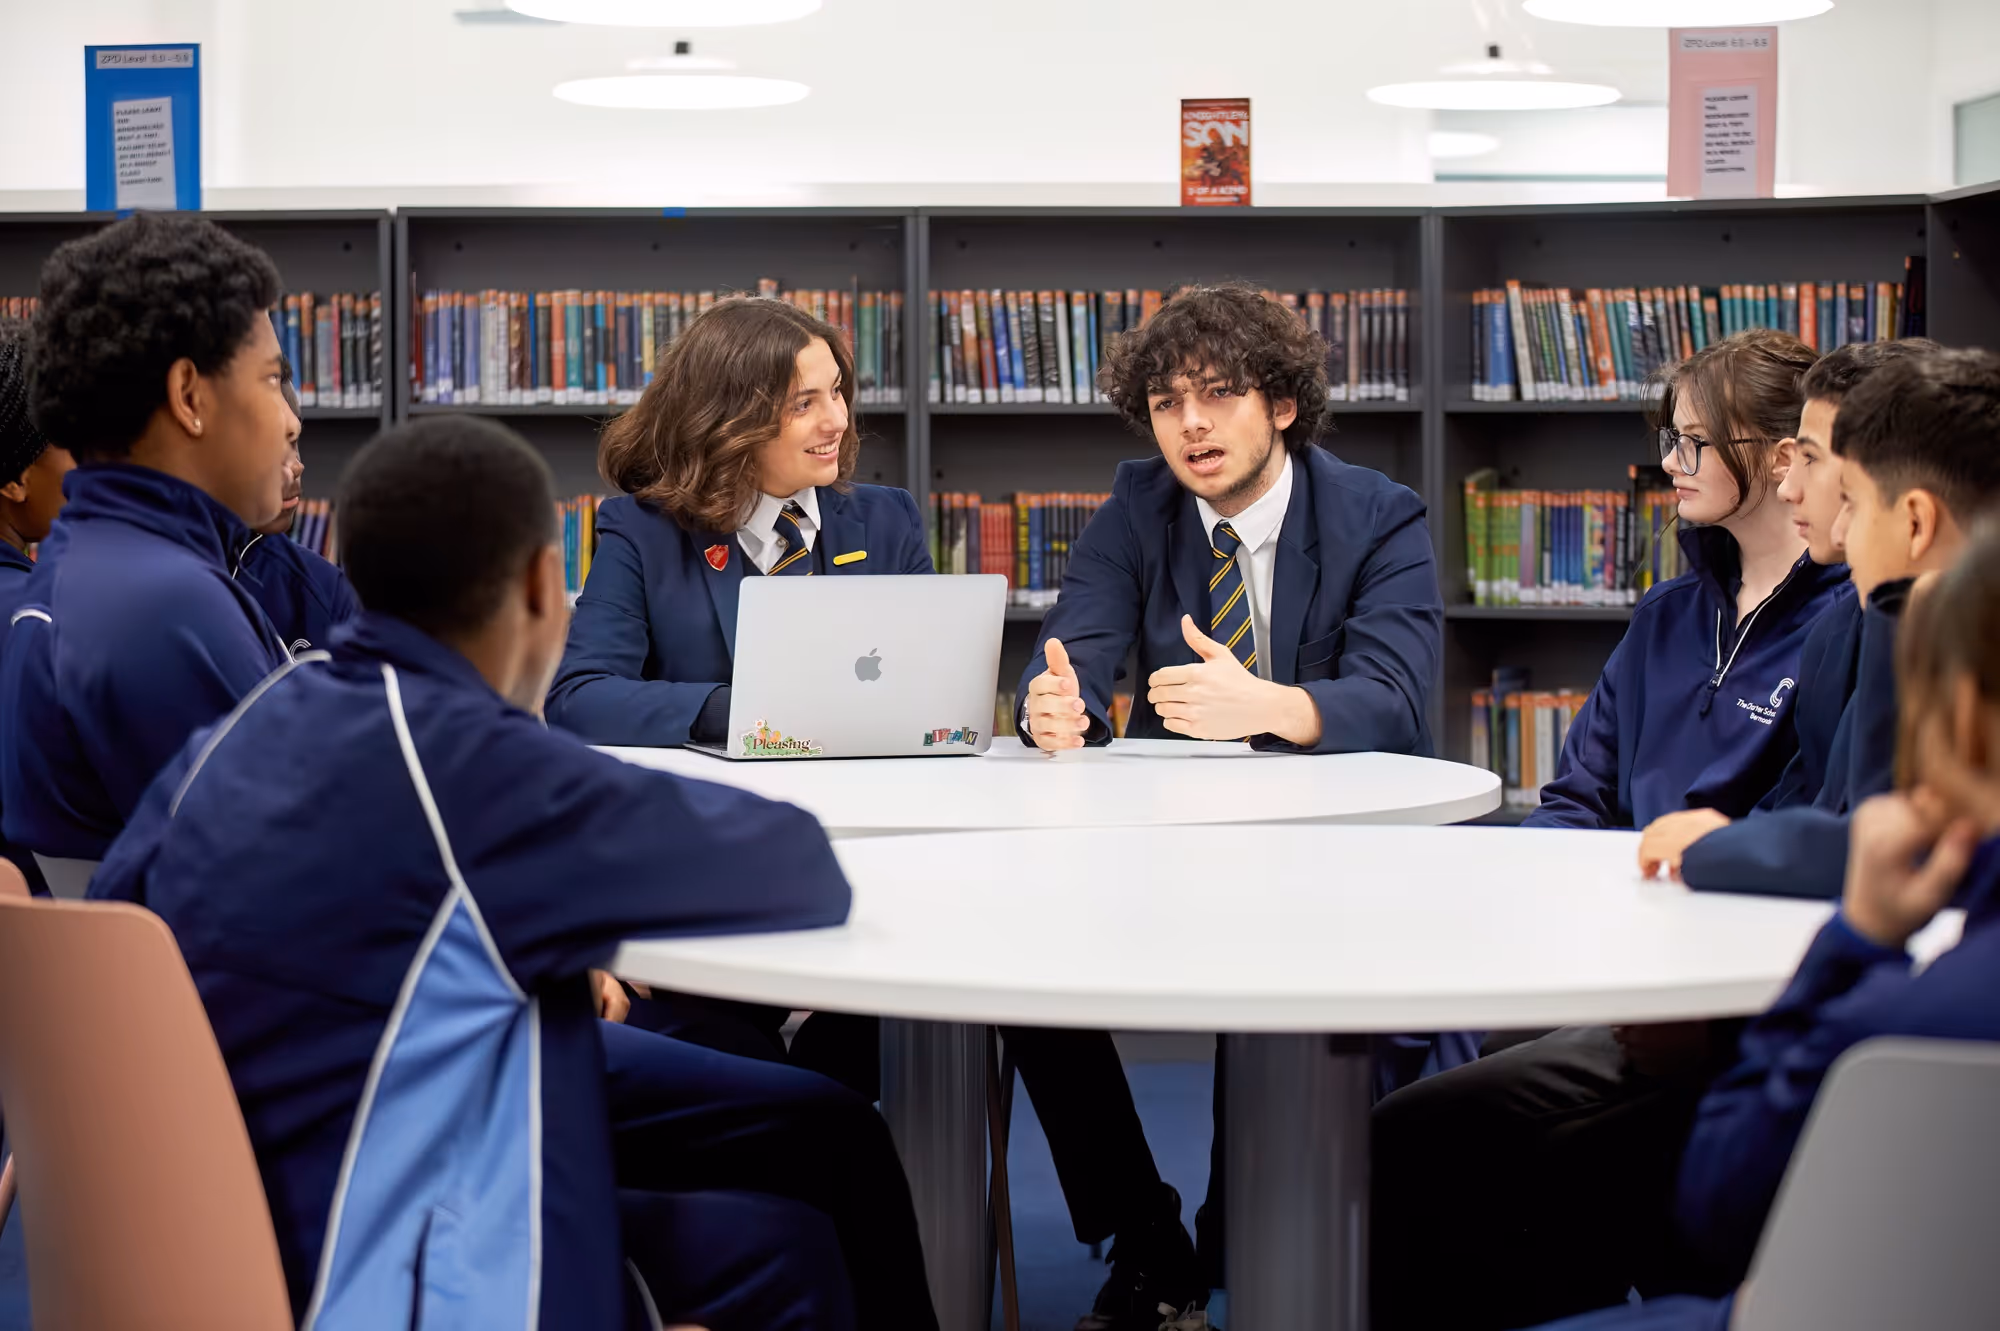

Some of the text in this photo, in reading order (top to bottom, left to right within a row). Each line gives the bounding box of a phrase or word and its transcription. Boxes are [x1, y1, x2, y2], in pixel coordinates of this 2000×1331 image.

[1183, 120, 1248, 147] SON
[1736, 698, 1747, 709] The
[753, 738, 811, 752] Pleasing
